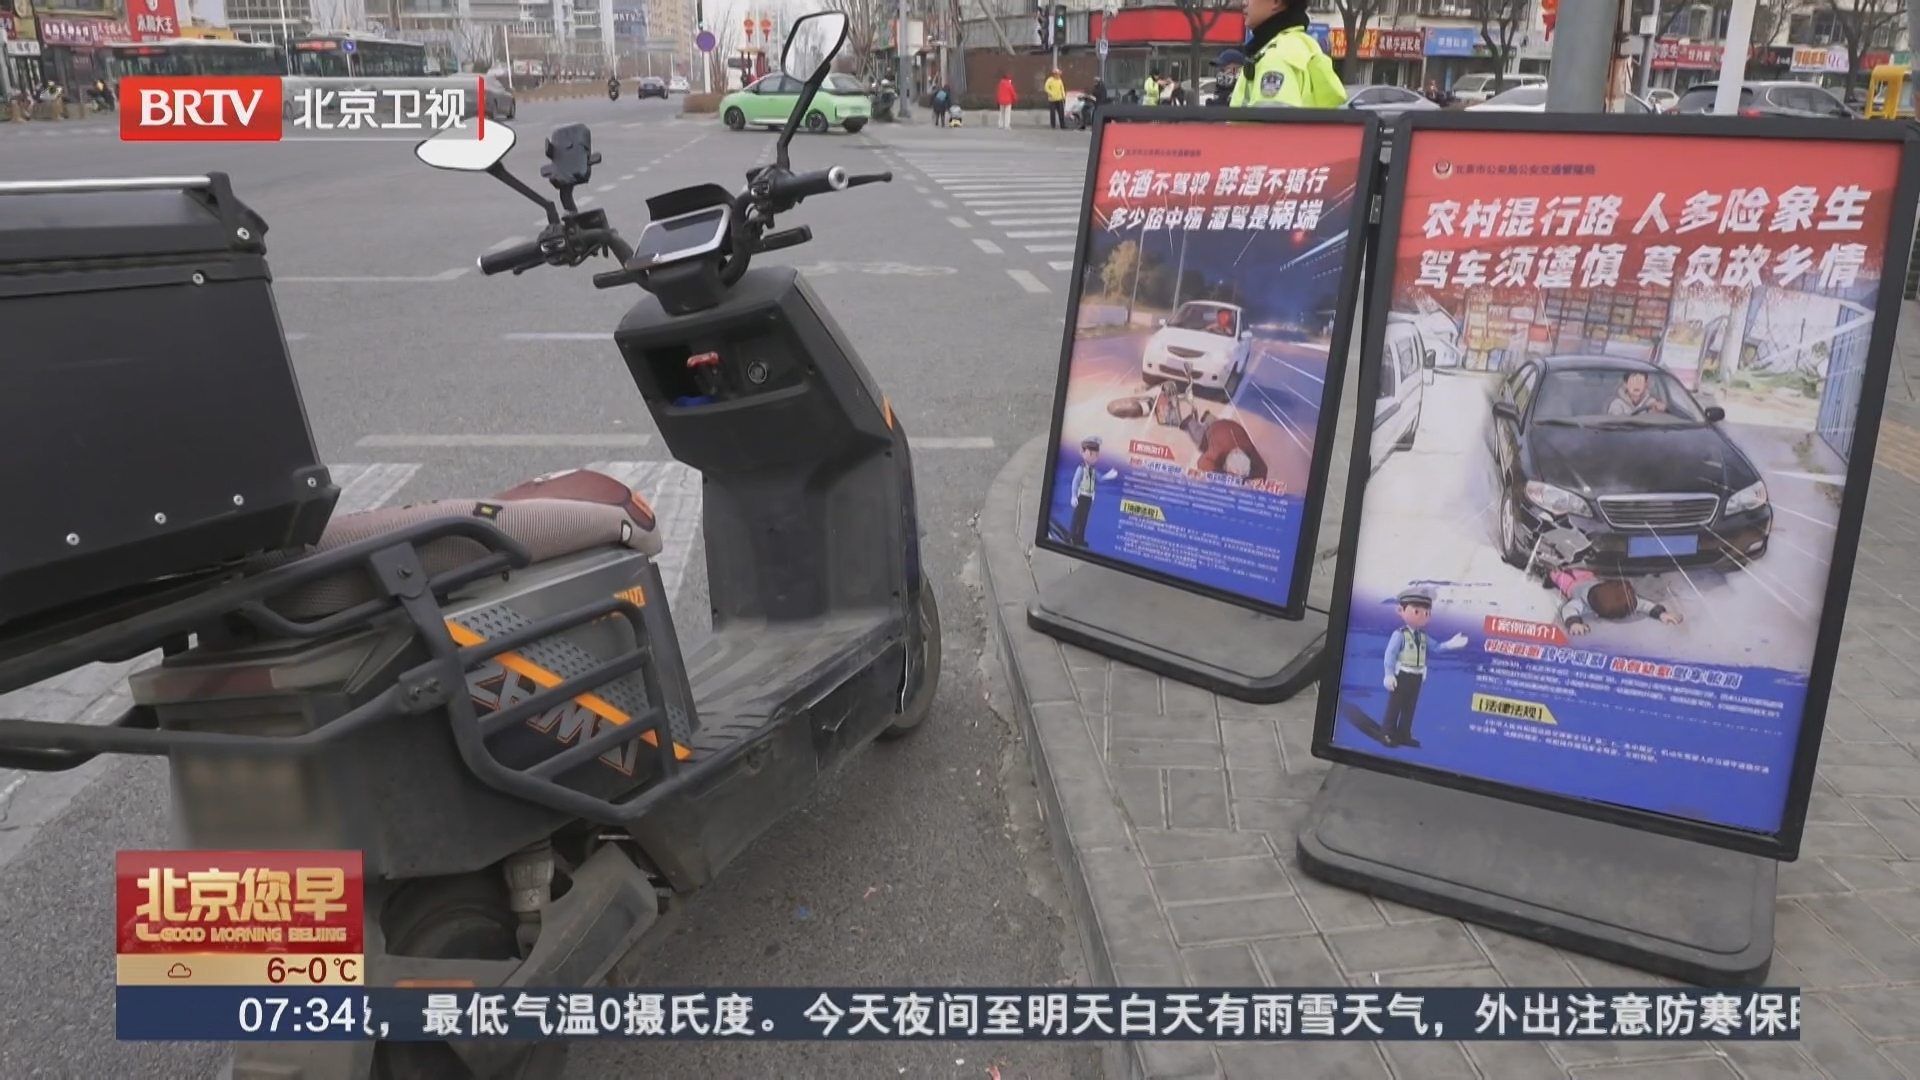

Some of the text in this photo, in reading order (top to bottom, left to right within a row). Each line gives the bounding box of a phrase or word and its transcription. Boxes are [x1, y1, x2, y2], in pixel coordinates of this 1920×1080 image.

[1108, 165, 1330, 198] 饮酒不驾驶 醉酒不骑行
[1207, 199, 1324, 231] 酒驾是祸端
[1421, 184, 1872, 239] 农村混行路 人多险象生
[1415, 242, 1868, 289] 驾车须谨慎 莫负故乡情
